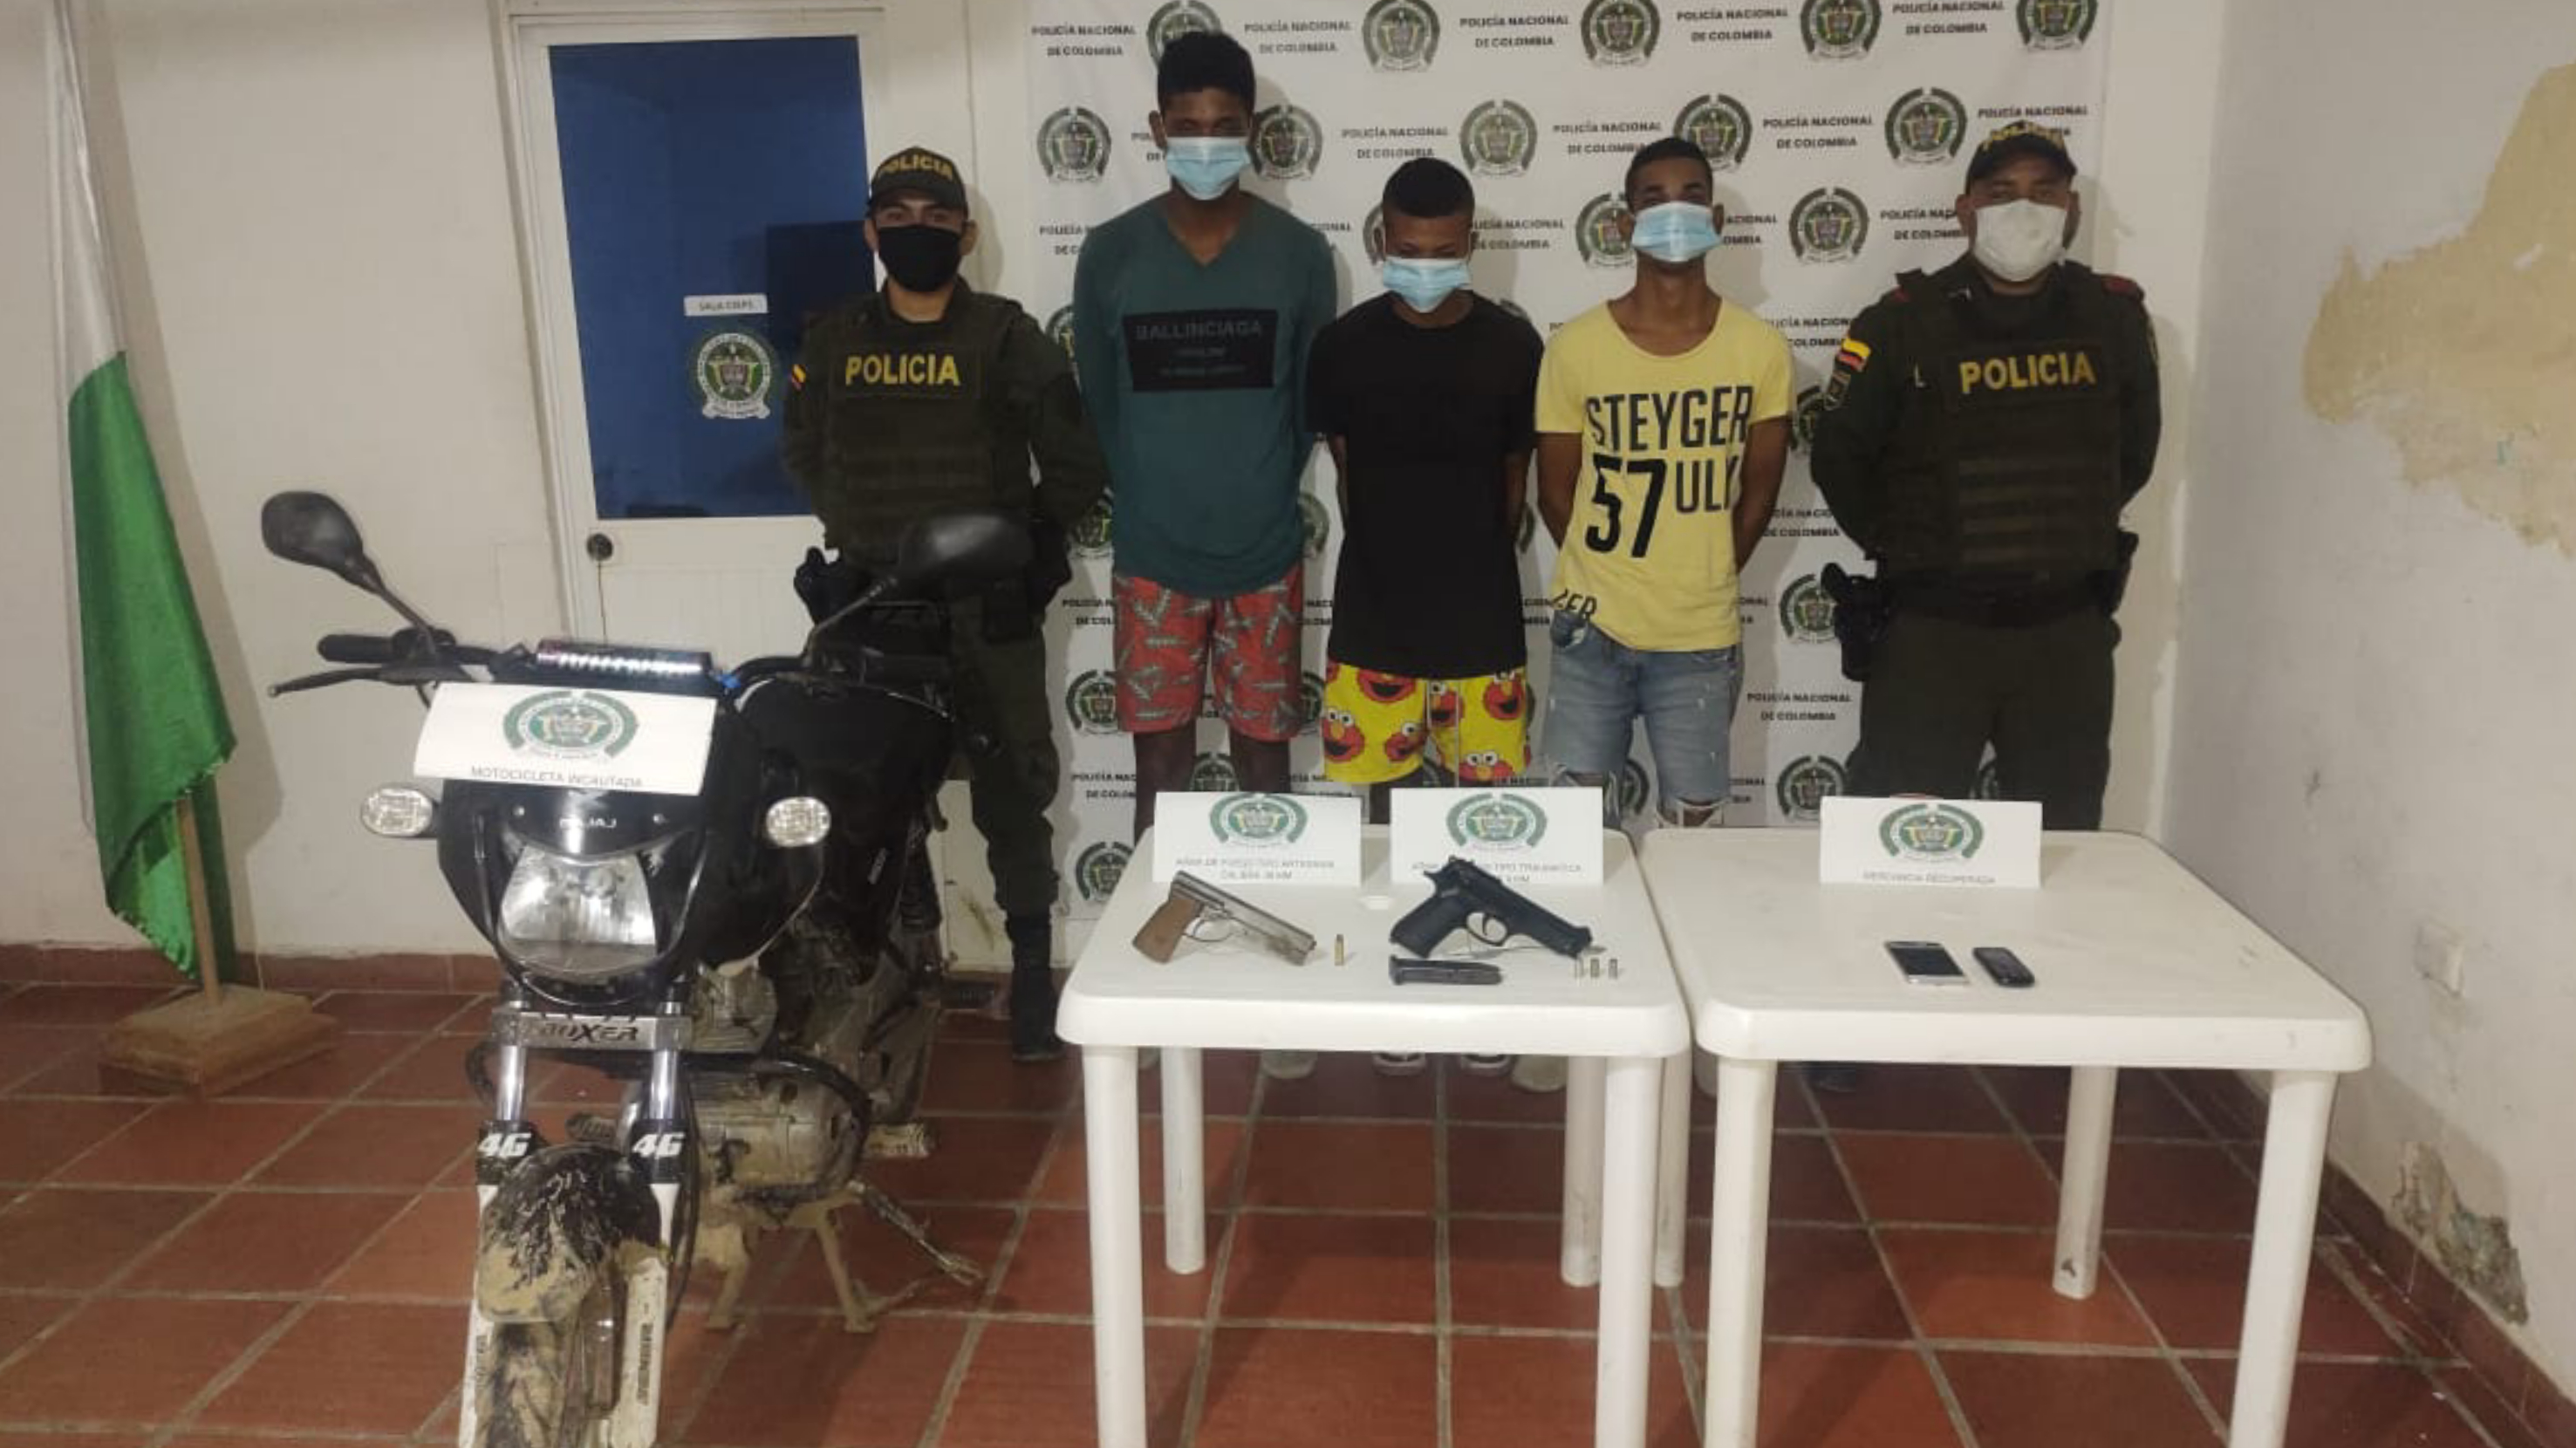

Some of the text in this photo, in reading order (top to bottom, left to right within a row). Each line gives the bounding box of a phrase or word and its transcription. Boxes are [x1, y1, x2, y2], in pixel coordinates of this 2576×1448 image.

[1942, 1, 2004, 13] NACIONAL
[1726, 8, 1788, 19] NACIONAL
[1291, 20, 1351, 31] NACIONAL
[1508, 15, 1568, 26] NACIONAL
[1078, 24, 1136, 35] NACIONAL
[1906, 23, 1987, 35] DE COLOMBIA
[1691, 30, 1772, 42] DE COLOMBIA
[1259, 42, 1336, 54] DE COLOMBIA
[1475, 37, 1554, 48] DE COLOMBIA
[1047, 45, 1123, 56] DE COLOMBIA
[2026, 105, 2087, 116] NACIONAL
[1812, 115, 1872, 126] NACIONAL
[1390, 126, 1448, 137] NACIONAL
[1602, 121, 1661, 133] NACIONAL
[1777, 137, 1857, 148] DE COLOMBIA
[1357, 147, 1434, 159] DE COLOMBIA
[1568, 145, 1582, 154] DE
[877, 154, 953, 181] POLICIA
[1894, 230, 1909, 240] DE
[1055, 245, 1069, 255] DE
[845, 354, 960, 386] POLICIA
[1959, 352, 2095, 393] POLICIA
[1586, 386, 1753, 452] STEYGER
[1585, 453, 1667, 558] 57
[1794, 693, 1851, 702] NACIONAL
[471, 765, 564, 782] MOTOCICLETA
